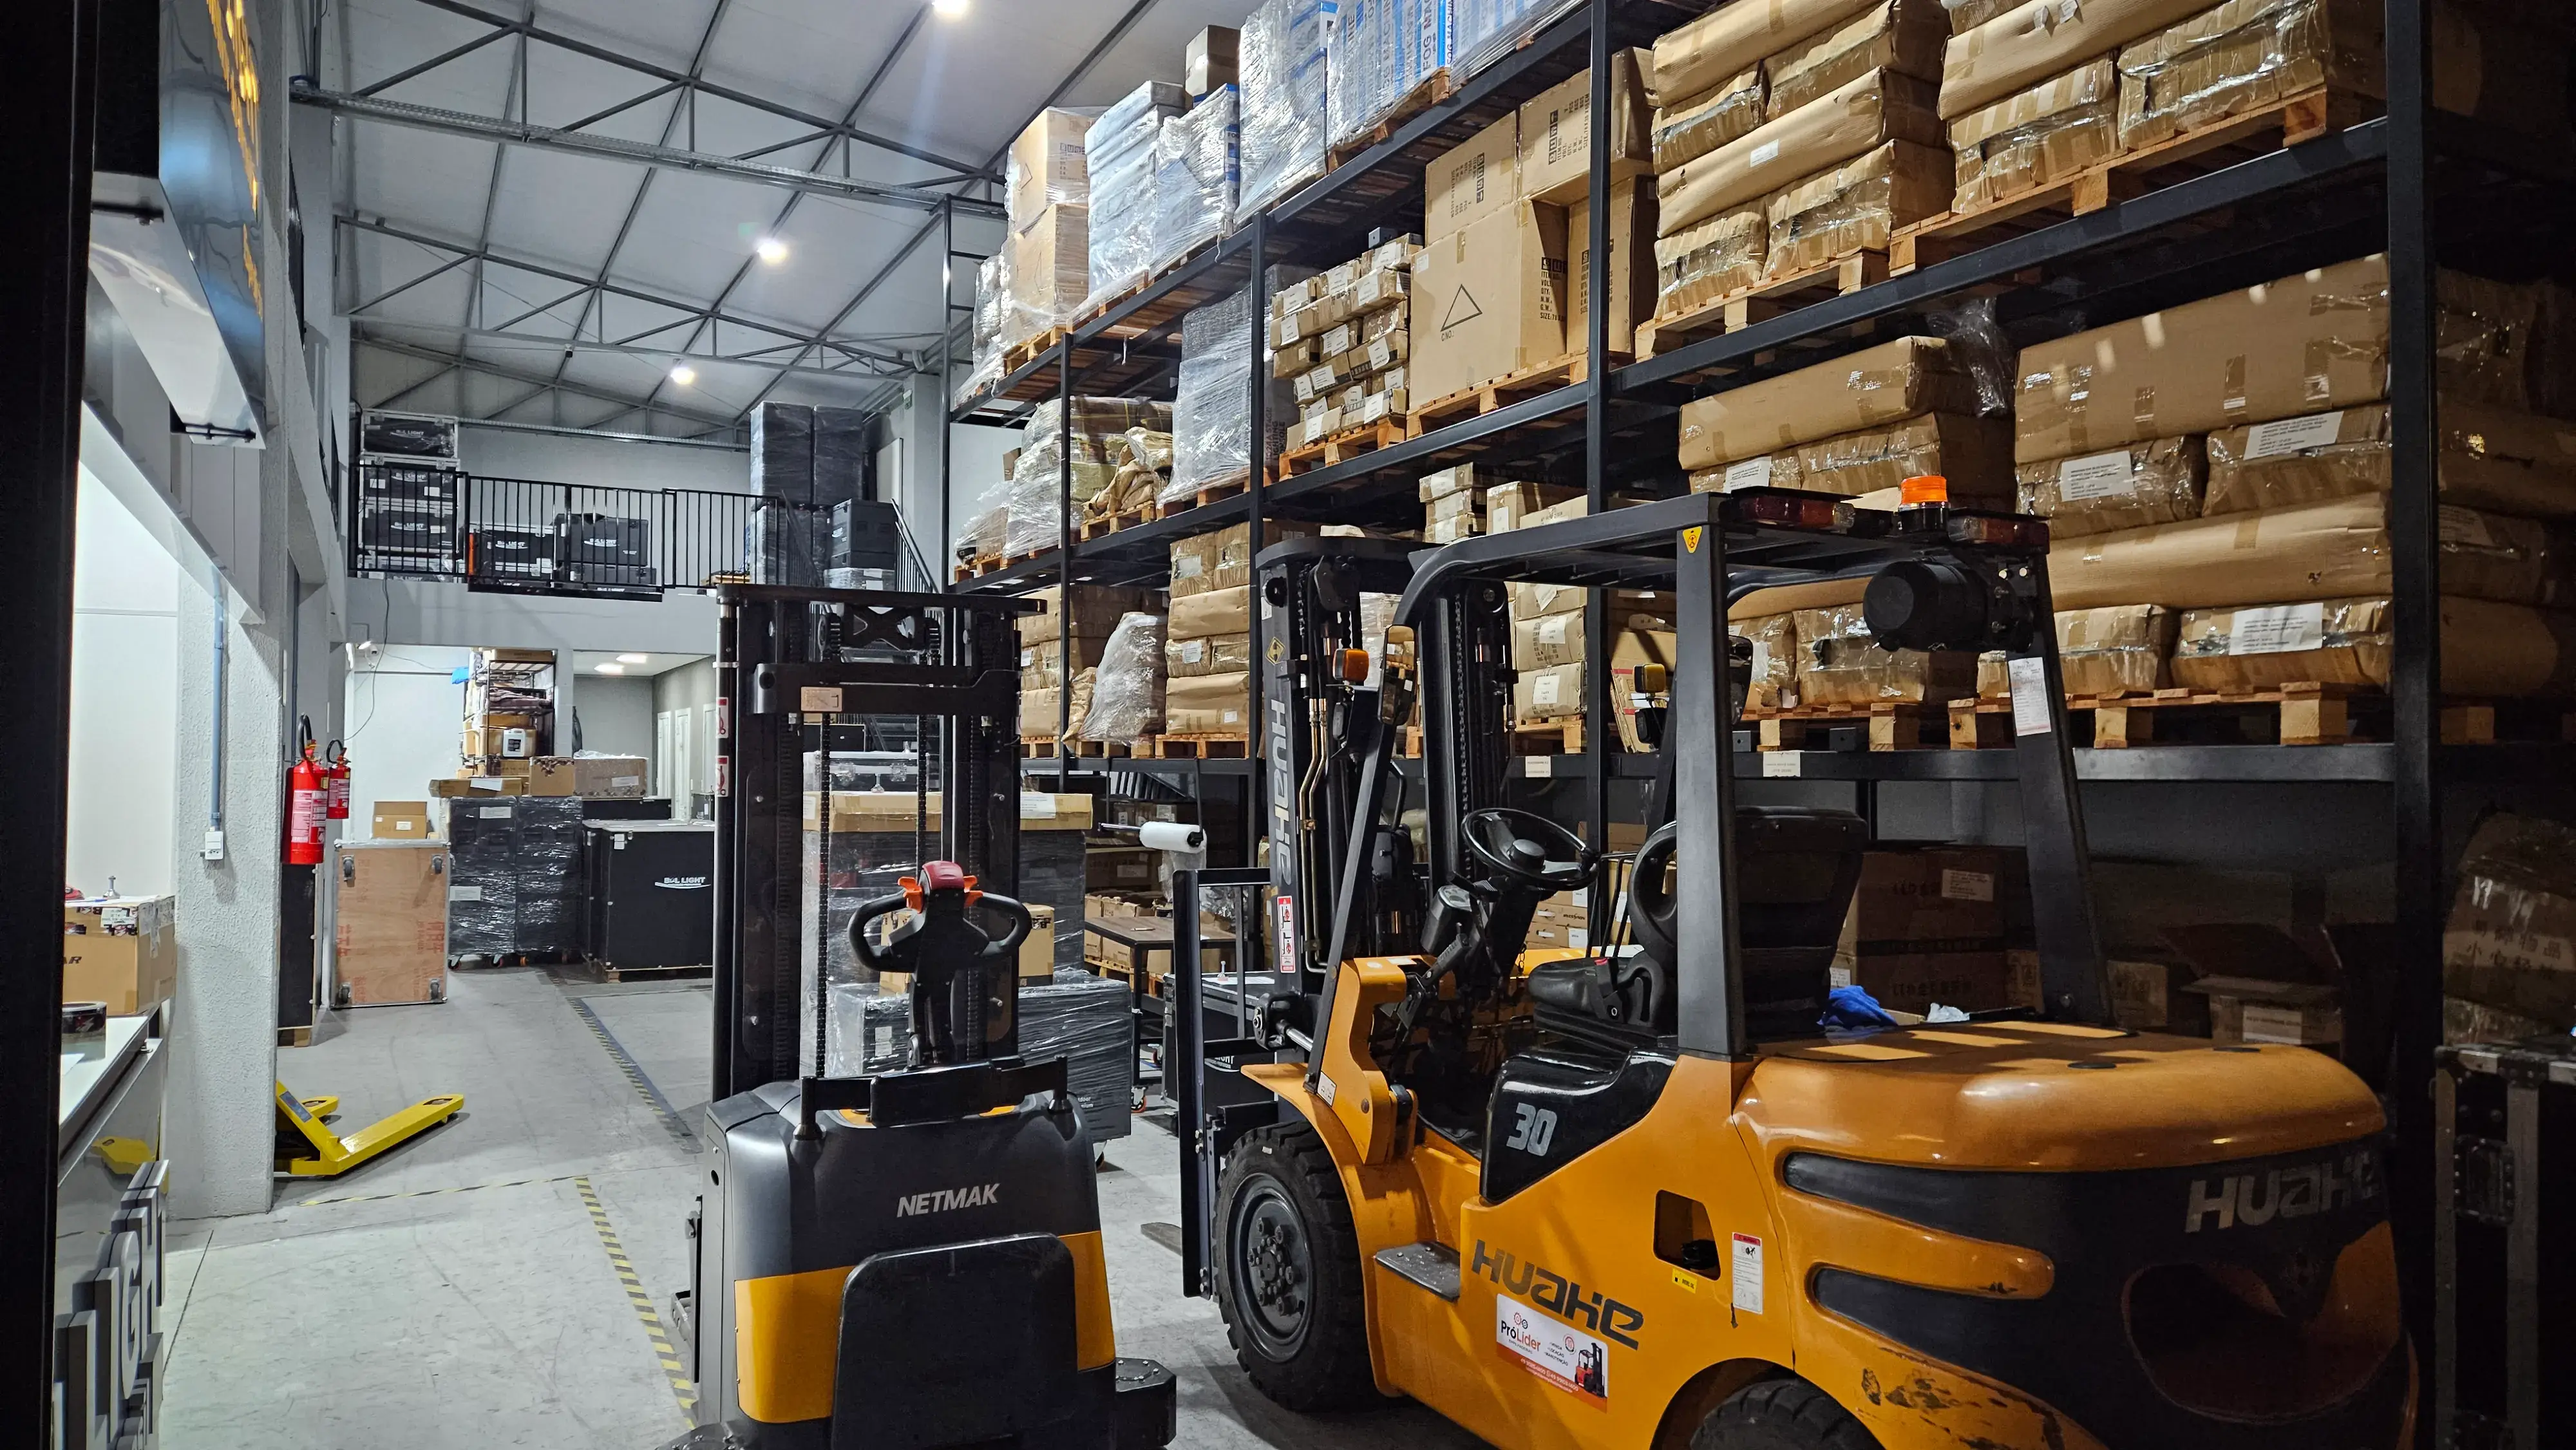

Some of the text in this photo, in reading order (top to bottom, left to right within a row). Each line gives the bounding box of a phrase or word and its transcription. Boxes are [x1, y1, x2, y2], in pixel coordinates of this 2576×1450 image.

[1422, 34, 1432, 72] FOG
[1506, 1102, 1557, 1156] 30
[896, 1183, 1000, 1218] NETMAK
